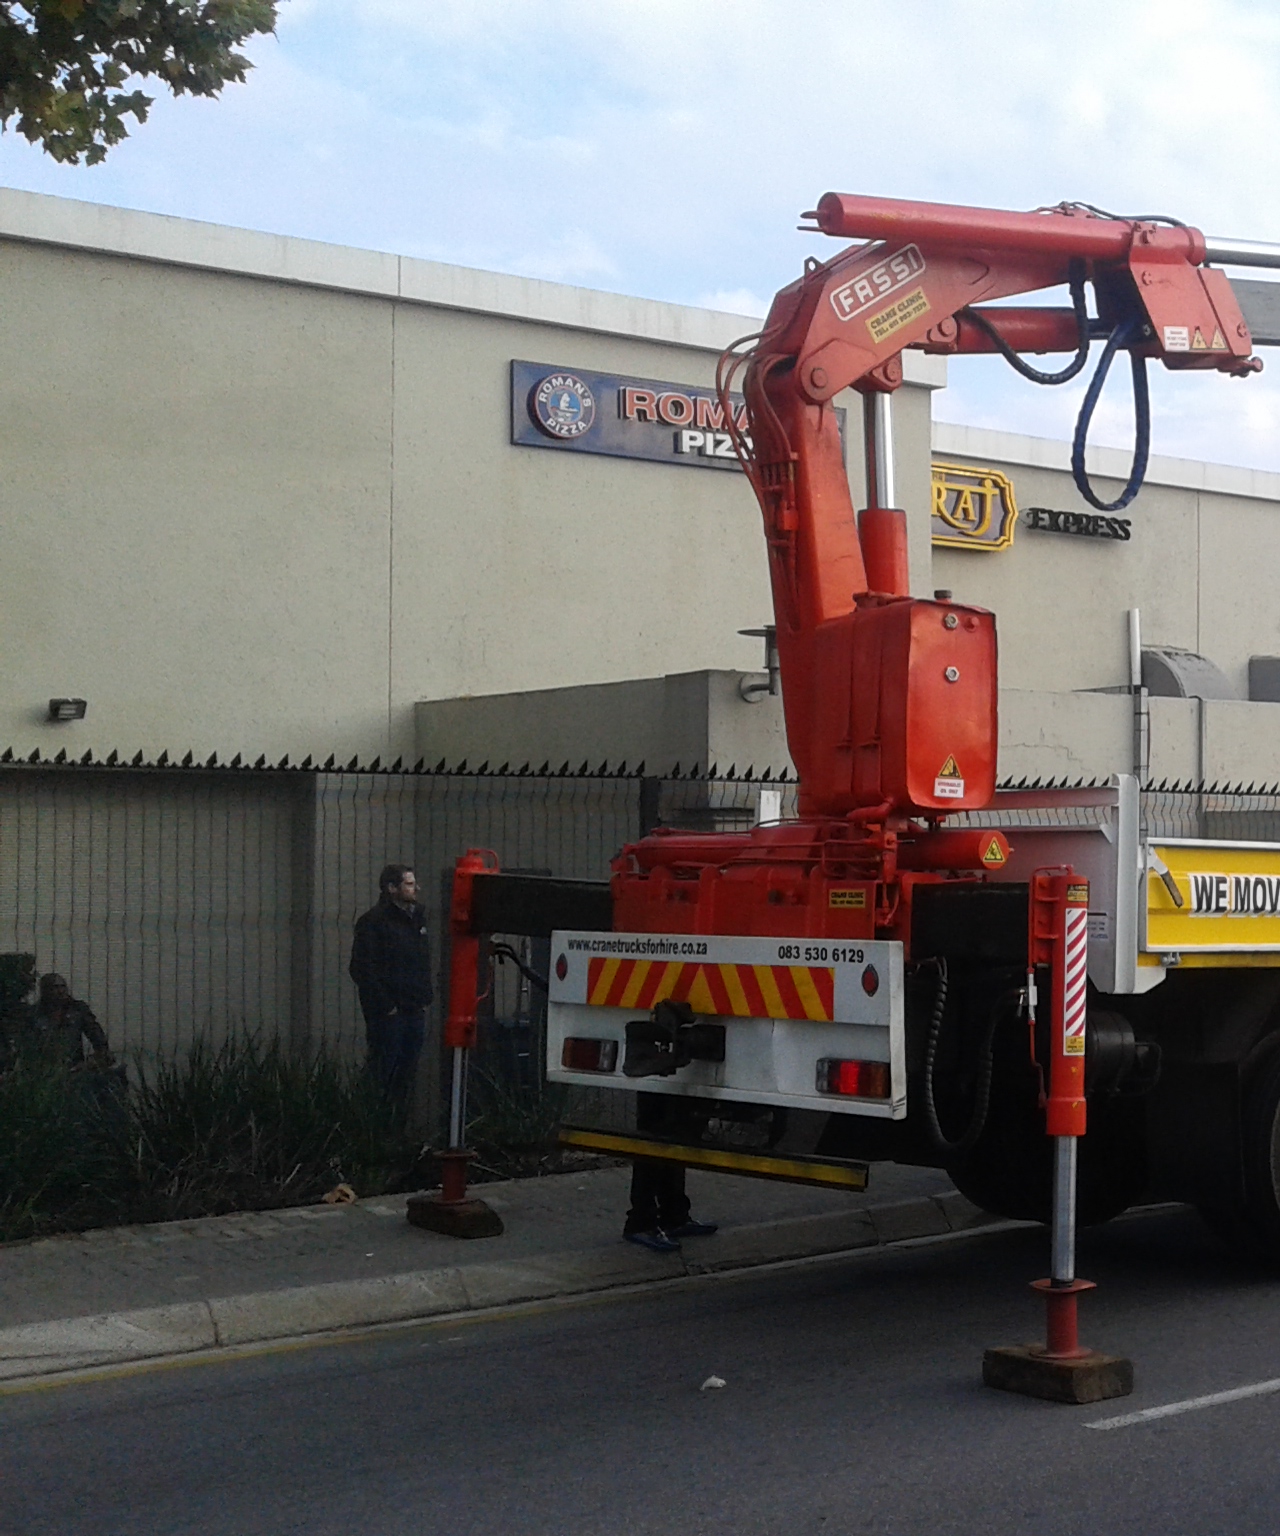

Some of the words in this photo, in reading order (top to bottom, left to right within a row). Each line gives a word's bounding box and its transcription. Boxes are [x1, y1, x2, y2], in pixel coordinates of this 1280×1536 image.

[838, 251, 918, 313] FASSI
[870, 307, 897, 329] CRANE
[897, 291, 923, 312] CLINIC
[538, 376, 592, 407] ROMAN'S
[546, 417, 587, 435] PIZZA
[1026, 507, 1132, 541] EXPRESS
[1193, 875, 1228, 914] WE
[567, 937, 708, 955] www.cranetrucksforhire.co.za
[778, 945, 800, 959] 083
[804, 947, 828, 961] 530
[832, 948, 864, 963] 6129
